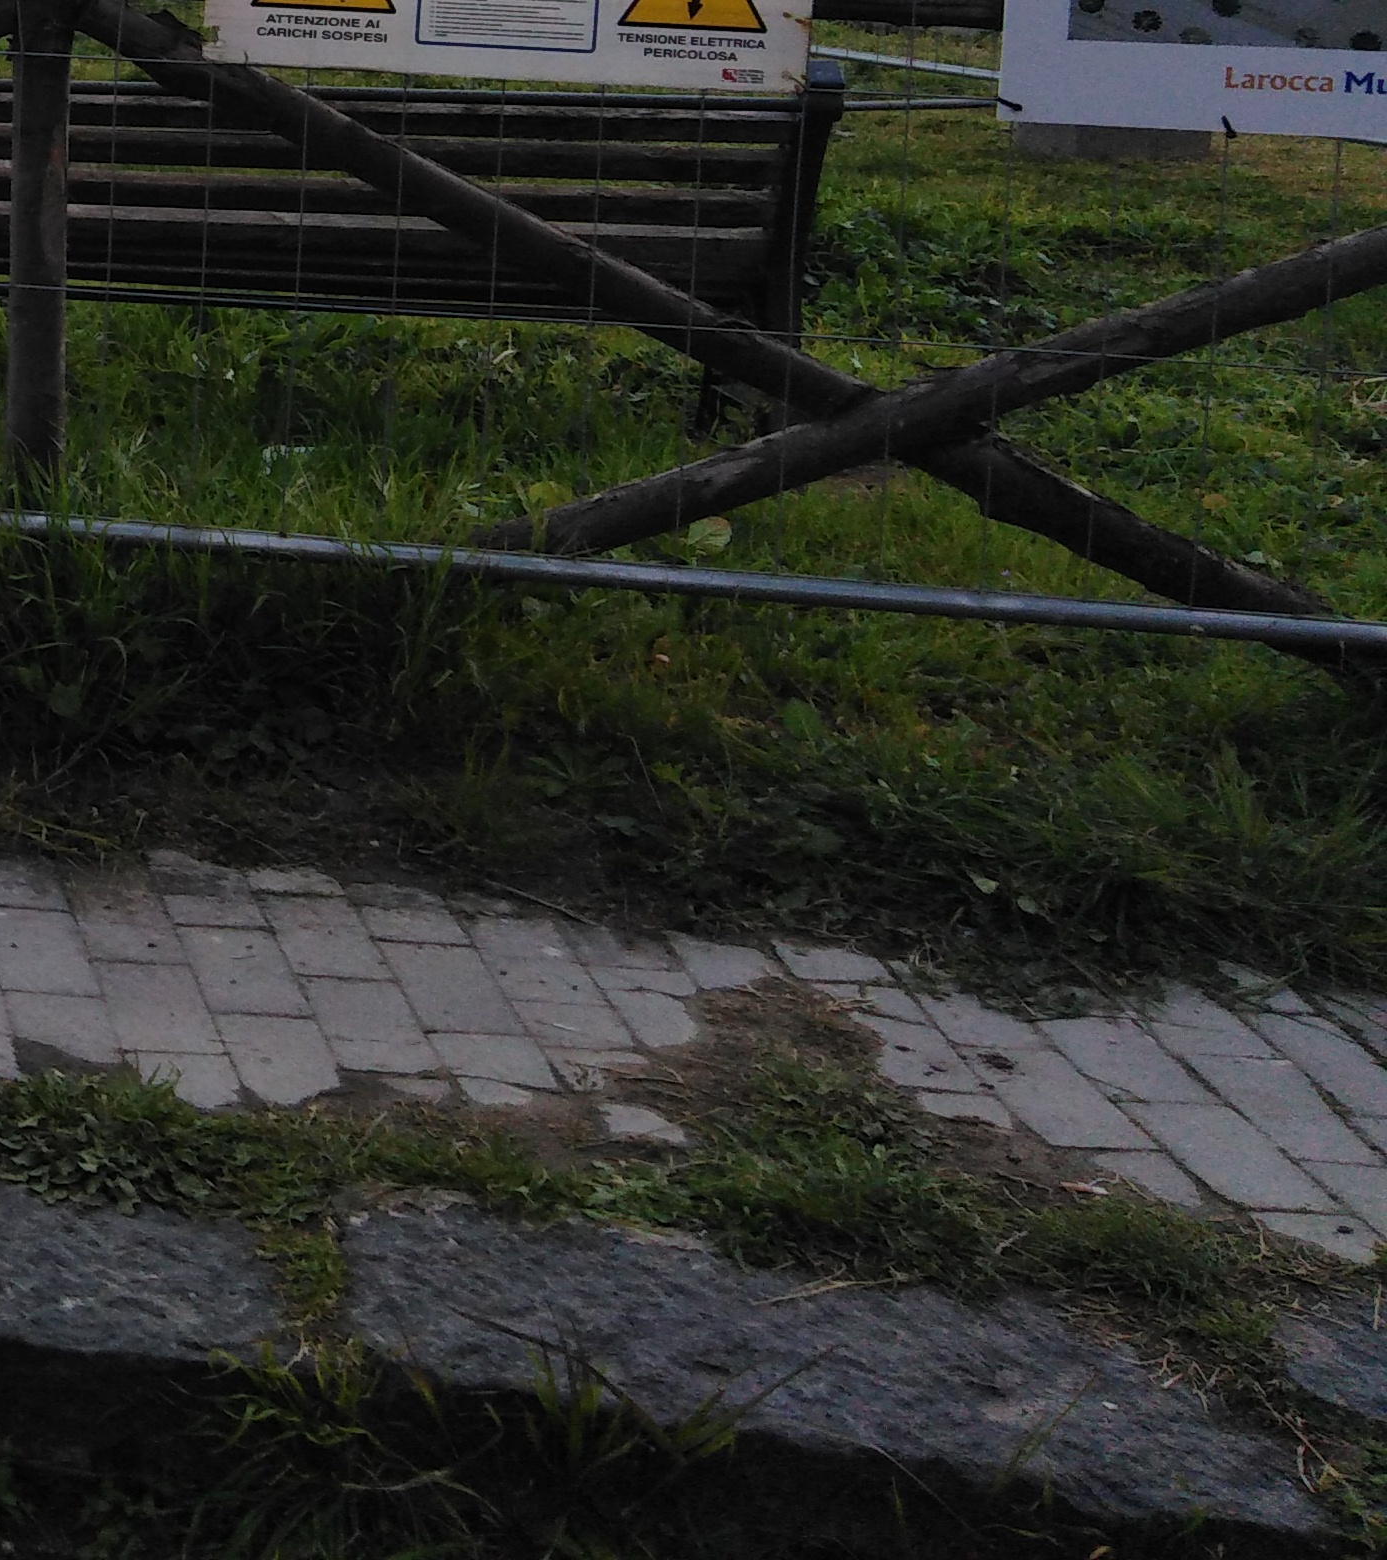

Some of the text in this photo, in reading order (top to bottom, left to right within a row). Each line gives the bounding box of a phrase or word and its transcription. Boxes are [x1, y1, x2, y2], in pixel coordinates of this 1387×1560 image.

[266, 13, 380, 29] ATTENZIONE AI
[256, 26, 388, 43] CARICHI SOSPESI
[617, 32, 766, 49] TENSIONE ELETTRICA
[643, 47, 738, 62] PERICOLOSA
[1224, 65, 1334, 93] Larocca
